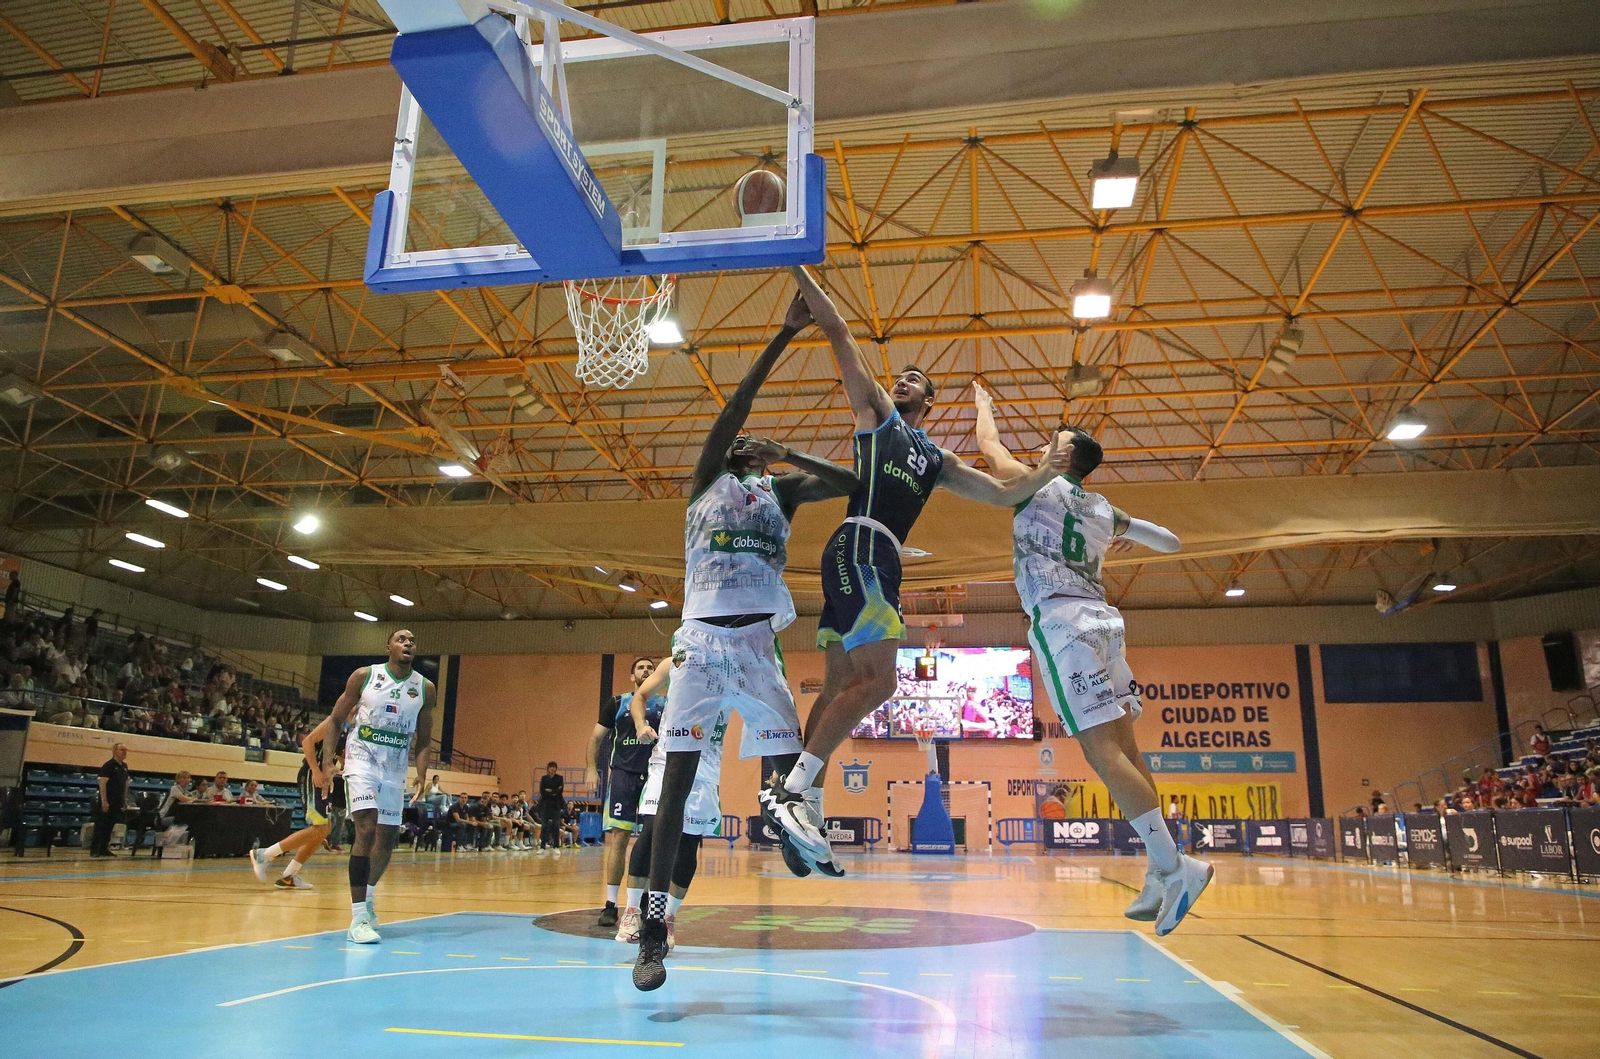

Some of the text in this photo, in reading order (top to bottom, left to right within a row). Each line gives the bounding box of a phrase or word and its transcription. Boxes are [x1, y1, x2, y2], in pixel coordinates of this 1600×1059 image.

[540, 94, 606, 214] SPORT SYSTEM
[907, 447, 928, 476] 29
[1062, 512, 1086, 562] 6
[834, 534, 853, 595] damex.io
[390, 688, 401, 699] 55
[1162, 706, 1269, 724] CIUDAD DE
[1161, 730, 1271, 748] ALGECIRAS
[613, 802, 622, 816] 2
[1053, 822, 1100, 838] NOP
[1540, 844, 1564, 855] LABOR
